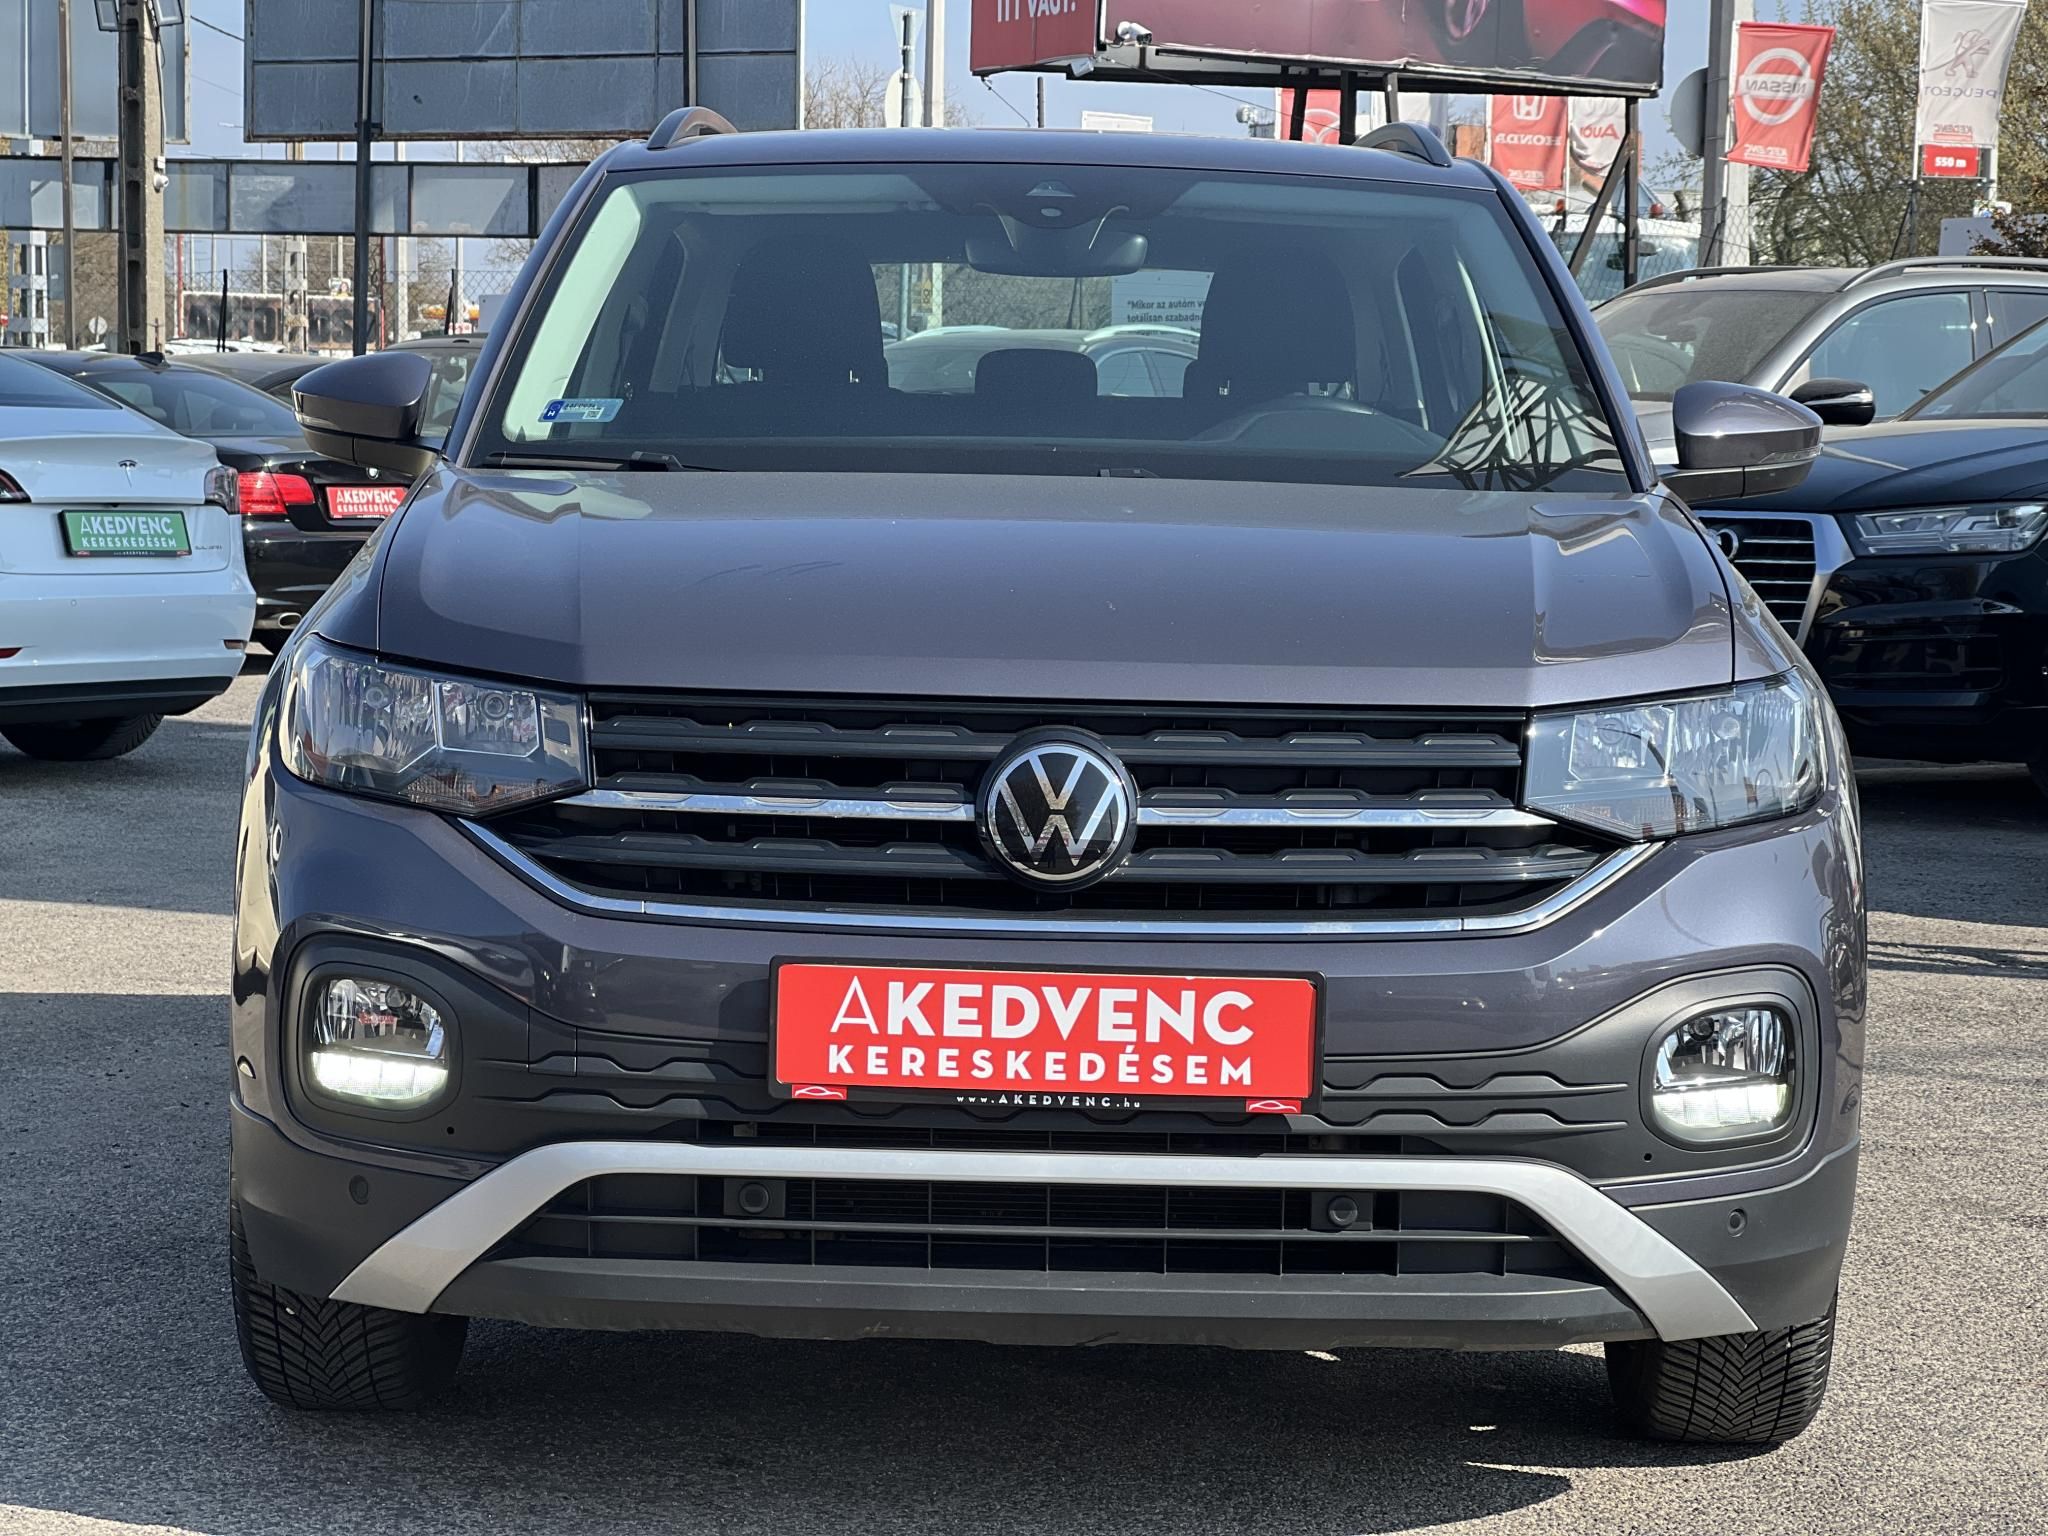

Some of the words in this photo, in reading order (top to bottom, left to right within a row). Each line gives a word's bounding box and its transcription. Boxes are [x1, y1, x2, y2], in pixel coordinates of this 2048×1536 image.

[1935, 157, 1953, 168] 550
[1956, 159, 1967, 168] m
[1156, 301, 1166, 309] az
[82, 536, 177, 548] KERESKEDÉSEM
[828, 1033, 1253, 1086] KERESKEDÉSEM
[956, 1094, 1141, 1108] www.AKEDVENC.hu
